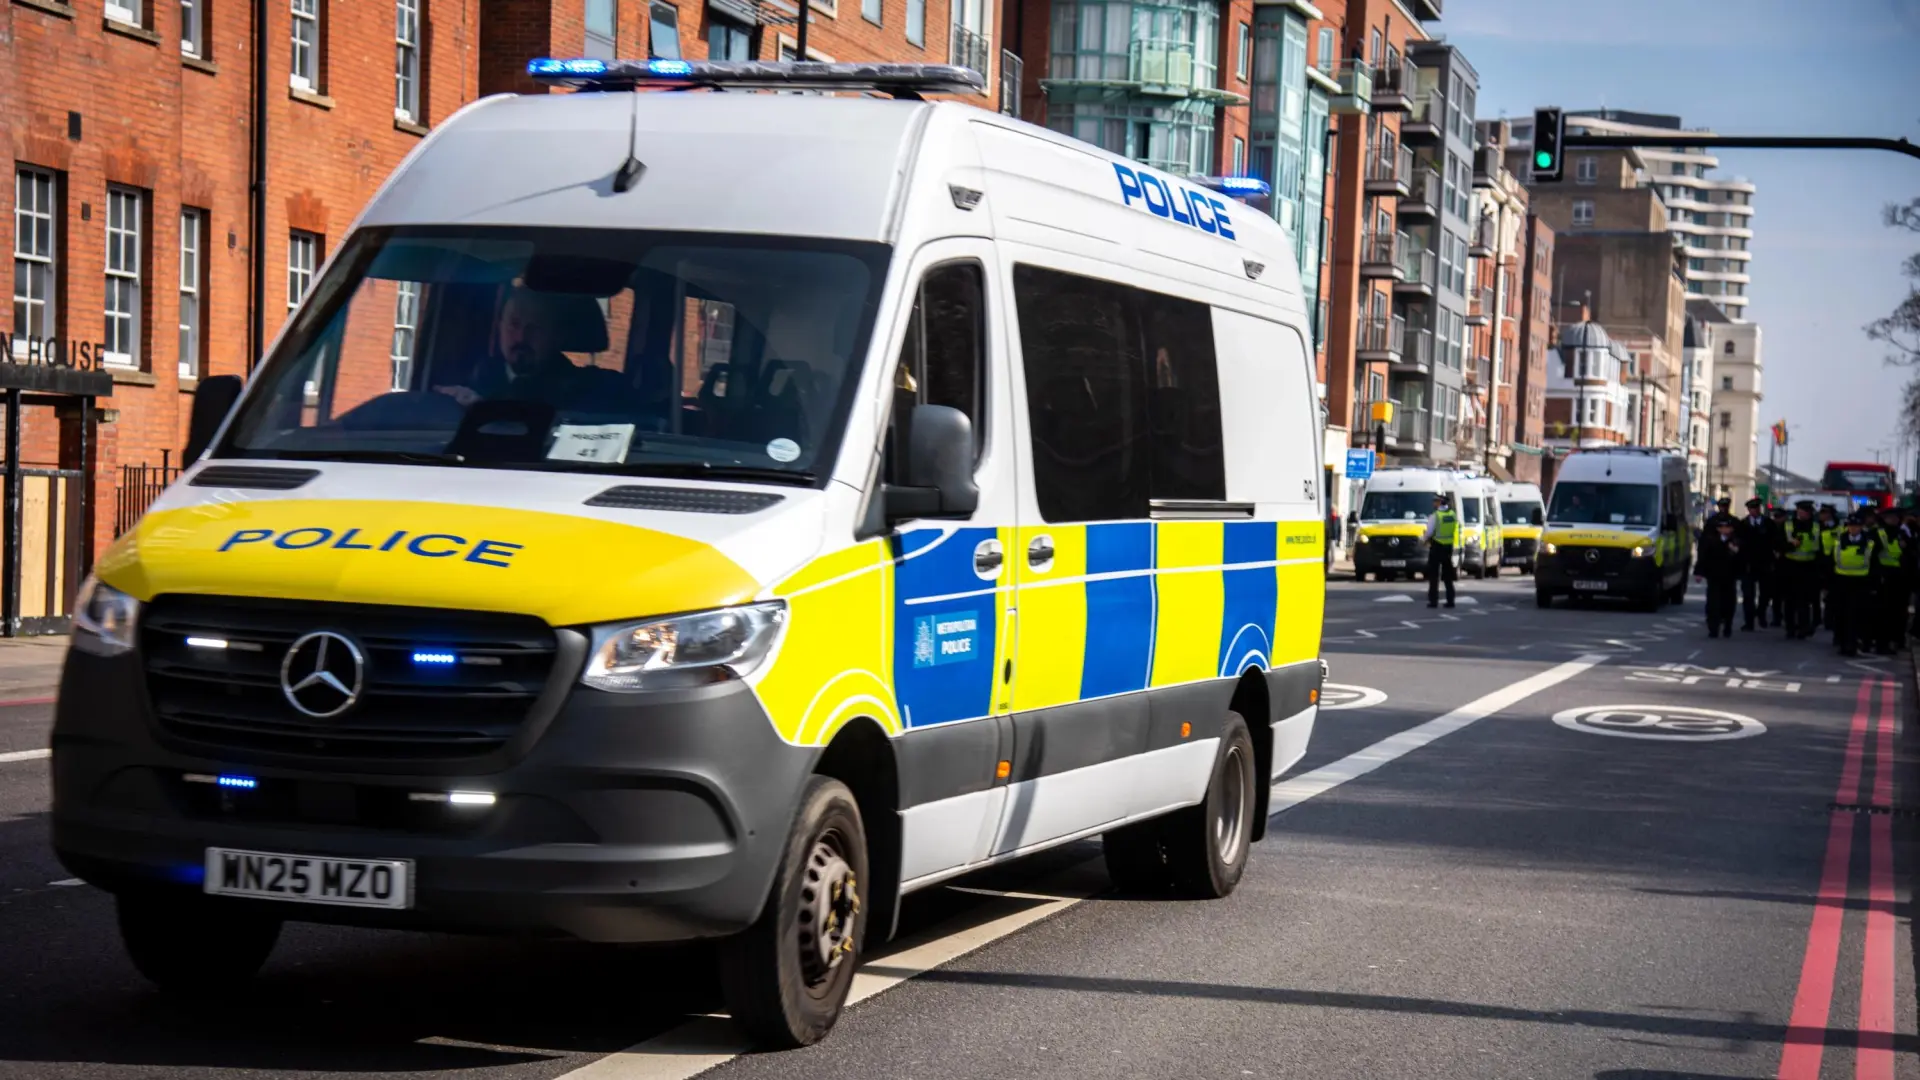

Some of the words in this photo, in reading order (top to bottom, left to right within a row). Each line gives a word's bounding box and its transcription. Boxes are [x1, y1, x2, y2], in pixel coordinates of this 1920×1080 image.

[1112, 162, 1236, 241] POLICE
[28, 334, 106, 372] HOUSE
[216, 528, 525, 568] POLICE
[221, 852, 311, 894] WN25
[320, 861, 392, 900] MZO
